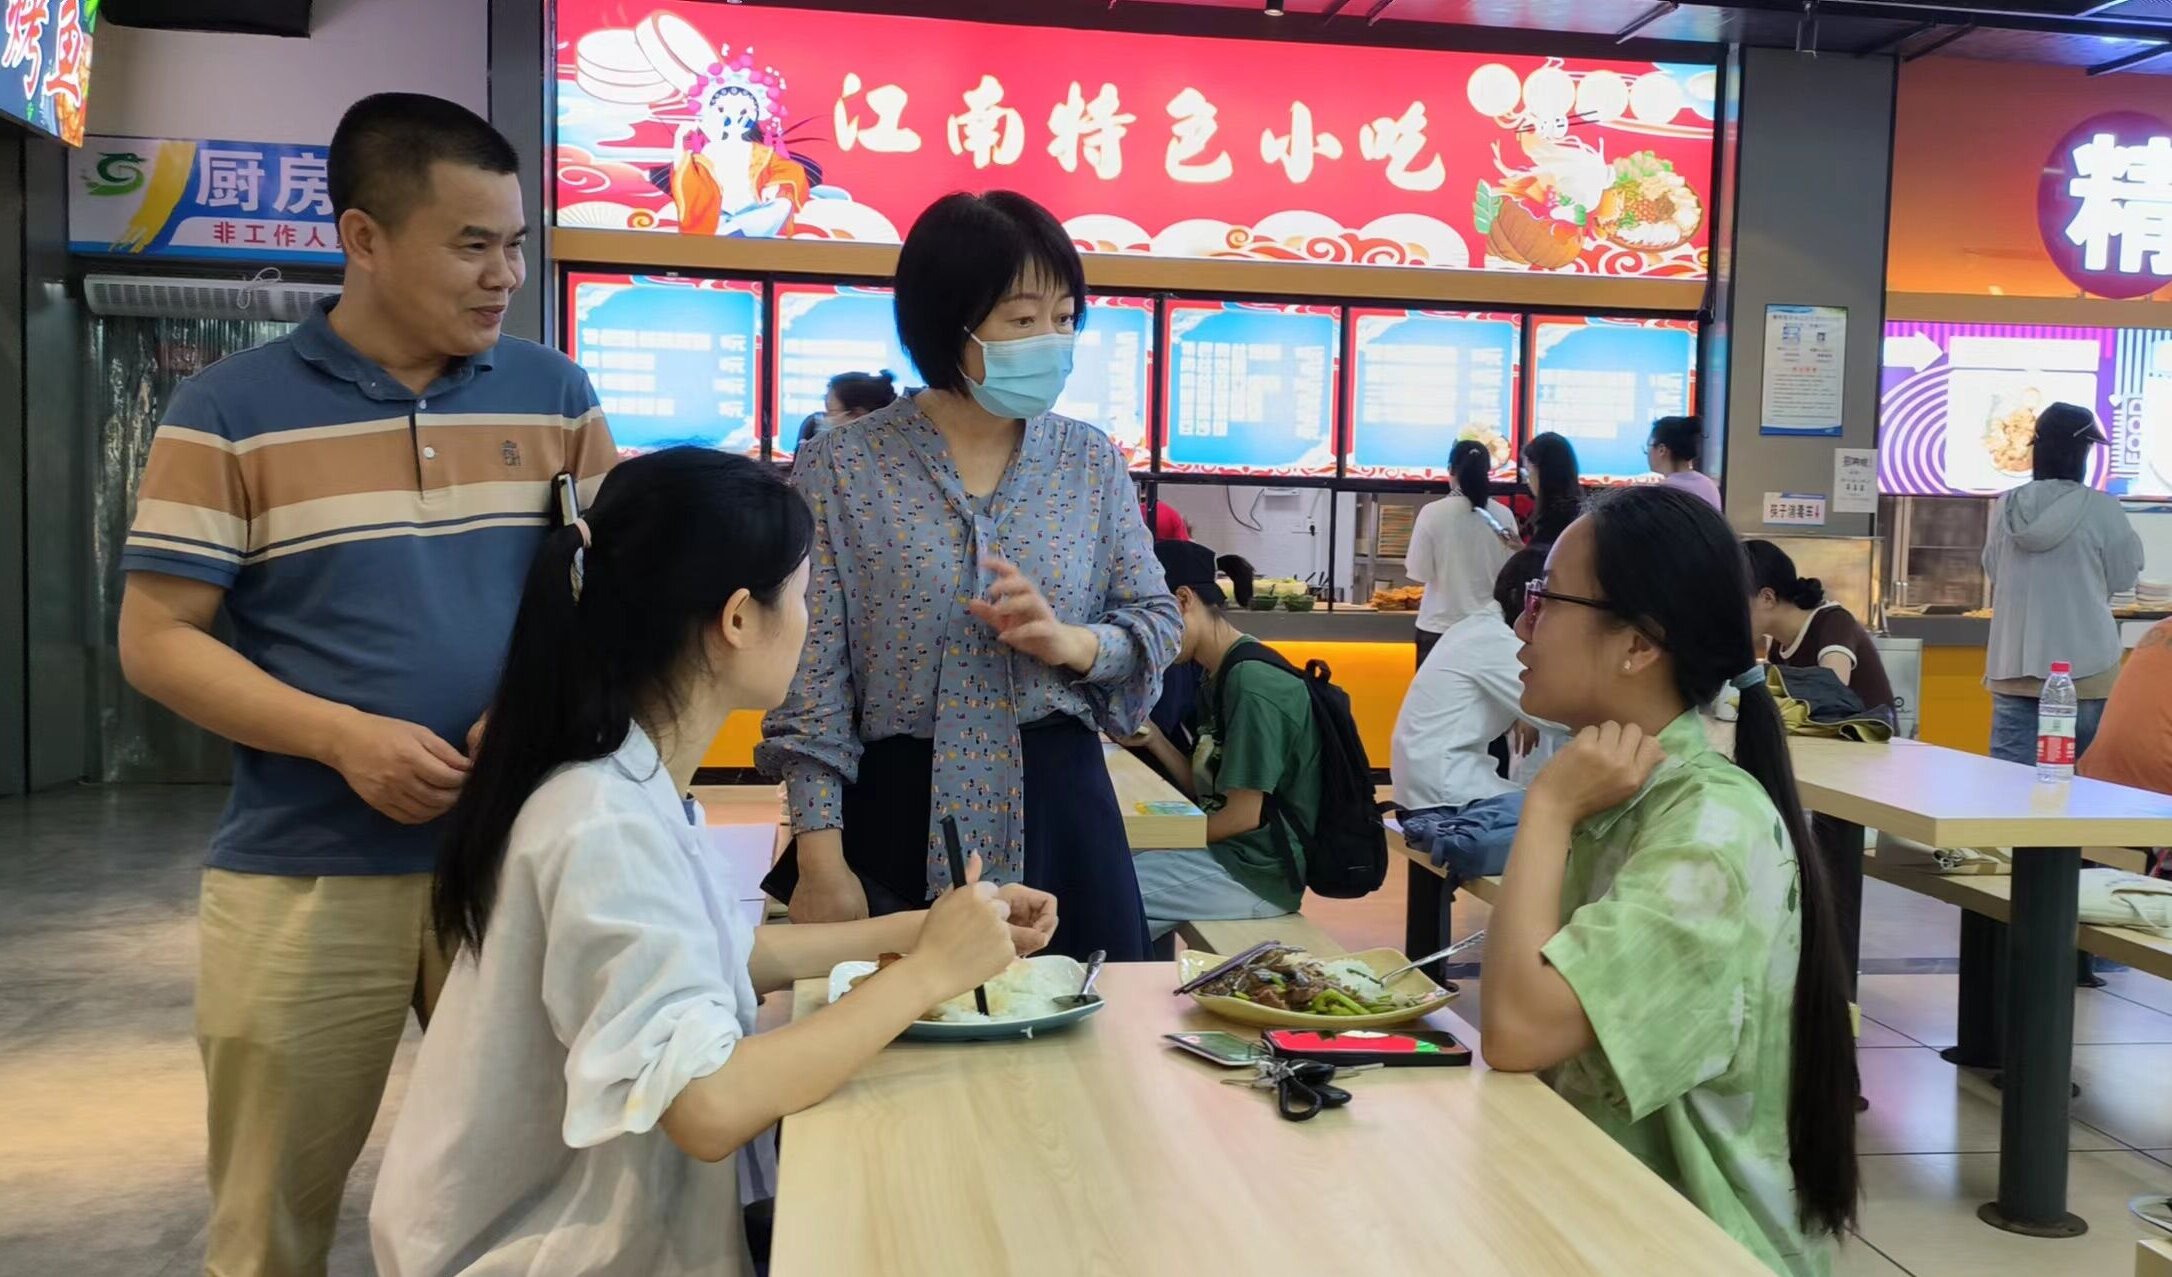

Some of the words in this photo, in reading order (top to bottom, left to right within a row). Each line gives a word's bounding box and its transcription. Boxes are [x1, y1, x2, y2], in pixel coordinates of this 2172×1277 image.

[833, 71, 1446, 194] 江南特色小吃
[195, 149, 335, 217] 厨房
[2065, 132, 2172, 276] 精
[212, 221, 342, 249] 非工作人
